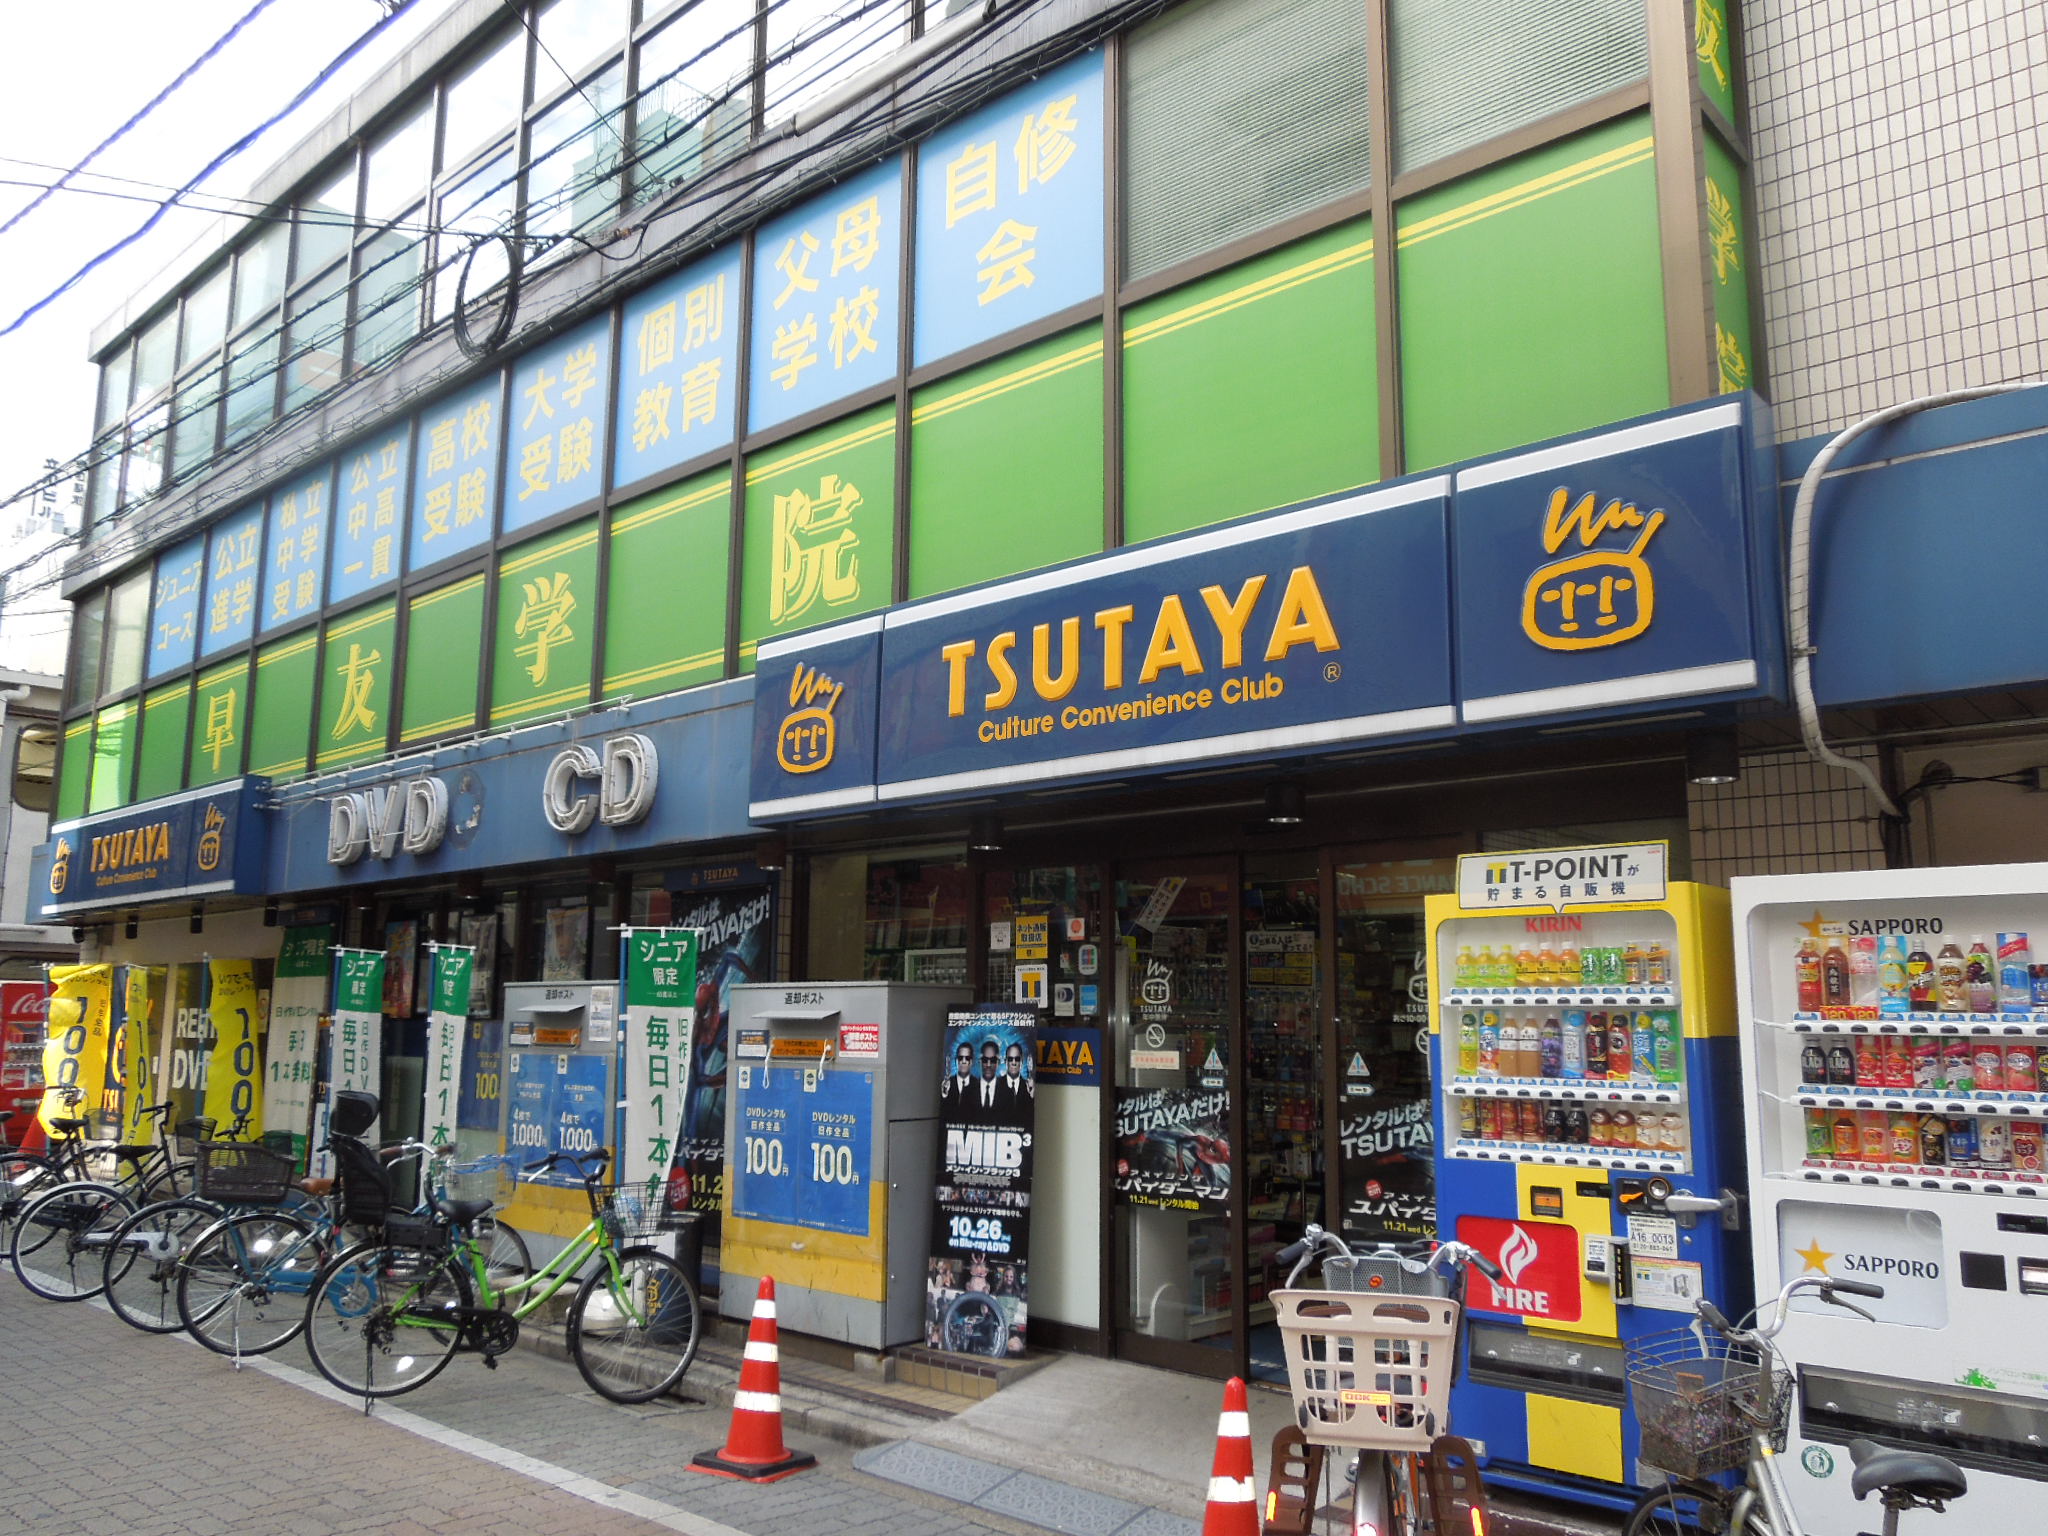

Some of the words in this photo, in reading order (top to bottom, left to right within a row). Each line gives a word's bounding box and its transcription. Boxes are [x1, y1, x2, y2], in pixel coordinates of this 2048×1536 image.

[945, 94, 1079, 230] 自修
[774, 195, 882, 310] 父母
[976, 217, 1039, 305] 会
[638, 272, 725, 376] 個別
[771, 286, 881, 392] 学校
[521, 341, 598, 429] 大学
[632, 362, 722, 454] 教育
[426, 398, 491, 473] 高校
[518, 415, 593, 501] 受験
[351, 437, 400, 496] 公立
[279, 481, 321, 528] 私立
[346, 484, 394, 541] 中高
[422, 467, 487, 542] 受験
[214, 523, 258, 581] 公立
[275, 527, 319, 577] 中学
[343, 535, 393, 582] 一貫
[209, 576, 252, 635] 進学
[271, 571, 315, 620] 受験
[513, 571, 577, 688] 学
[768, 472, 865, 627] 院
[157, 611, 194, 651] コース
[940, 564, 1341, 717] TSUTAYA
[977, 704, 1055, 743] Culture
[1058, 687, 1213, 729] Convenience
[1220, 672, 1284, 703] Club
[327, 776, 450, 867] DVD
[542, 732, 660, 836] CD
[90, 821, 169, 873] TSUTAYA
[703, 868, 739, 881] TSUTAYA
[1487, 881, 1627, 902] 貯まる自販機
[1525, 915, 1584, 933] KIRIN
[1848, 917, 1944, 936] SAPPORO
[346, 959, 376, 977] シニア
[640, 940, 689, 963] シニア
[652, 966, 680, 987] 限定
[784, 990, 825, 1005] 返却ポスト
[1139, 1004, 1173, 1014] TSUTAYA
[746, 1106, 786, 1119] DVDレンタル
[812, 1111, 856, 1124] DVDレンタル
[949, 1216, 1003, 1241] 10.26
[1843, 1253, 1940, 1280] SAPPORO
